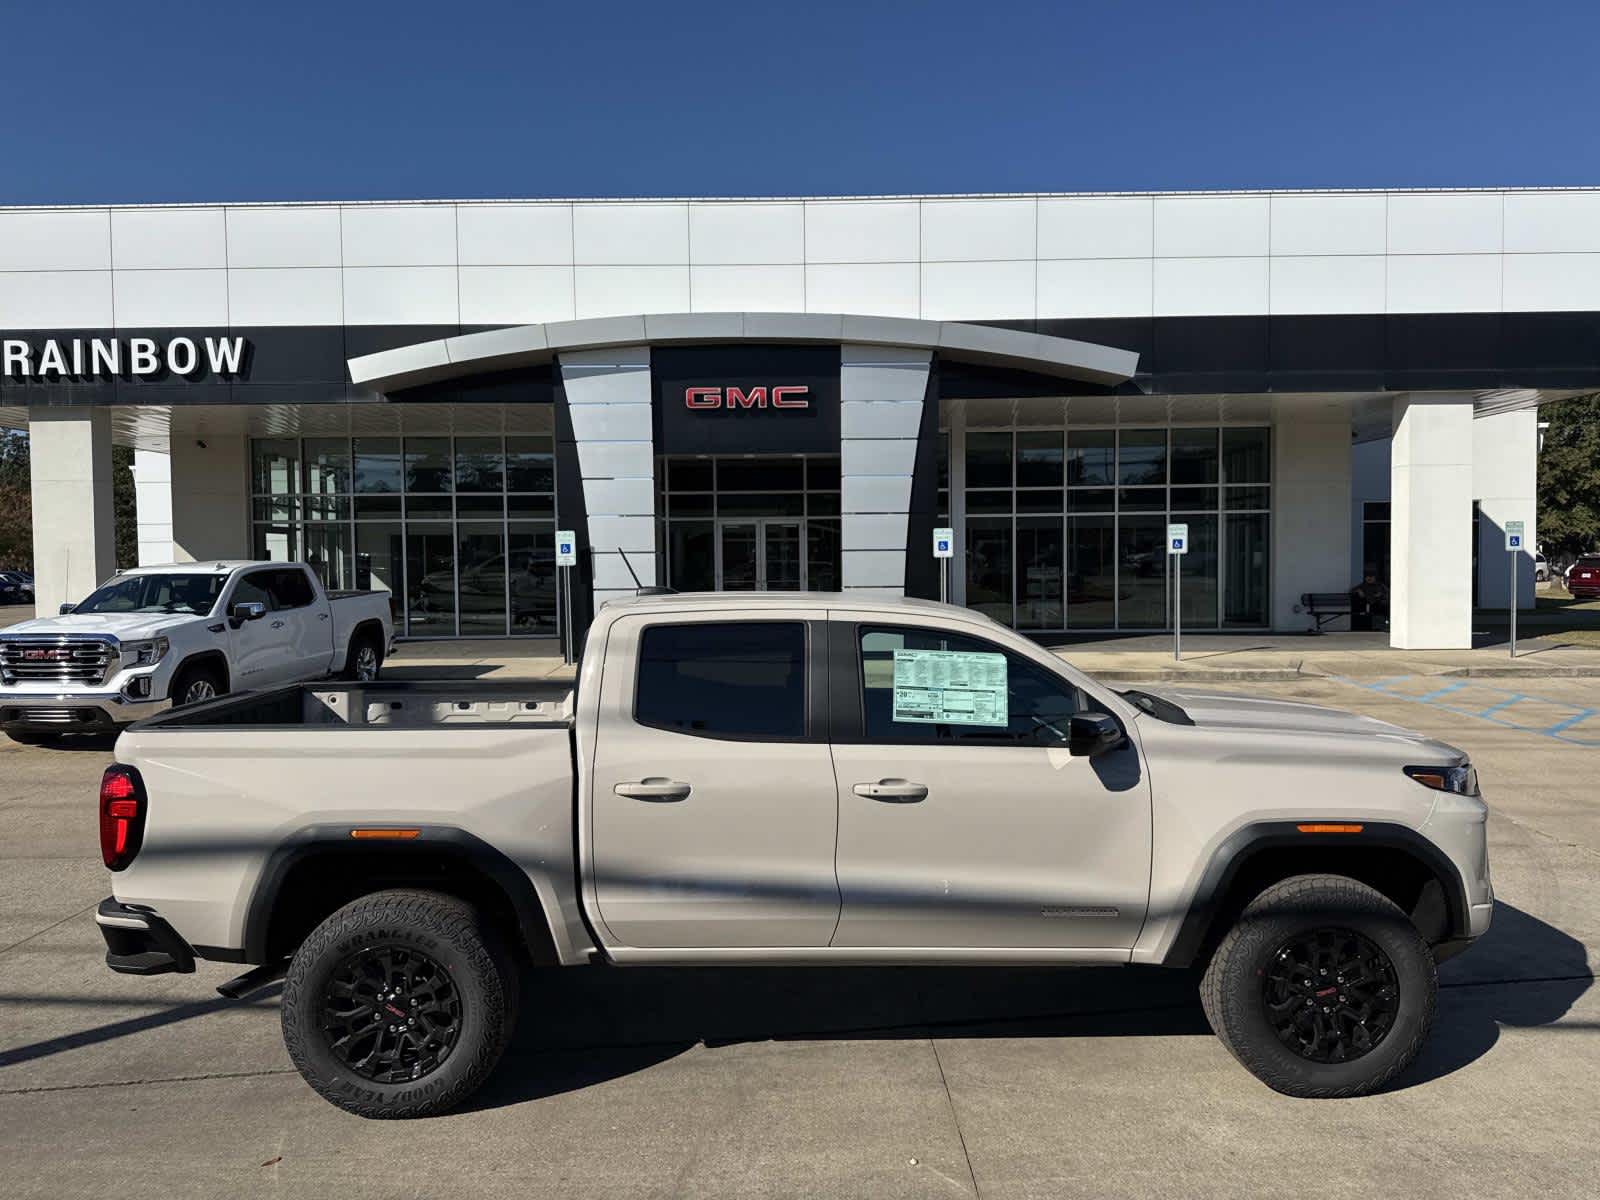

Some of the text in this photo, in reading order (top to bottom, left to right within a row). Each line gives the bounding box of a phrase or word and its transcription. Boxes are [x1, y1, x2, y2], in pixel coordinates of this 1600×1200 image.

[3, 337, 243, 375] RAINBOW
[685, 386, 809, 409] GMC
[24, 650, 70, 660] GMC
